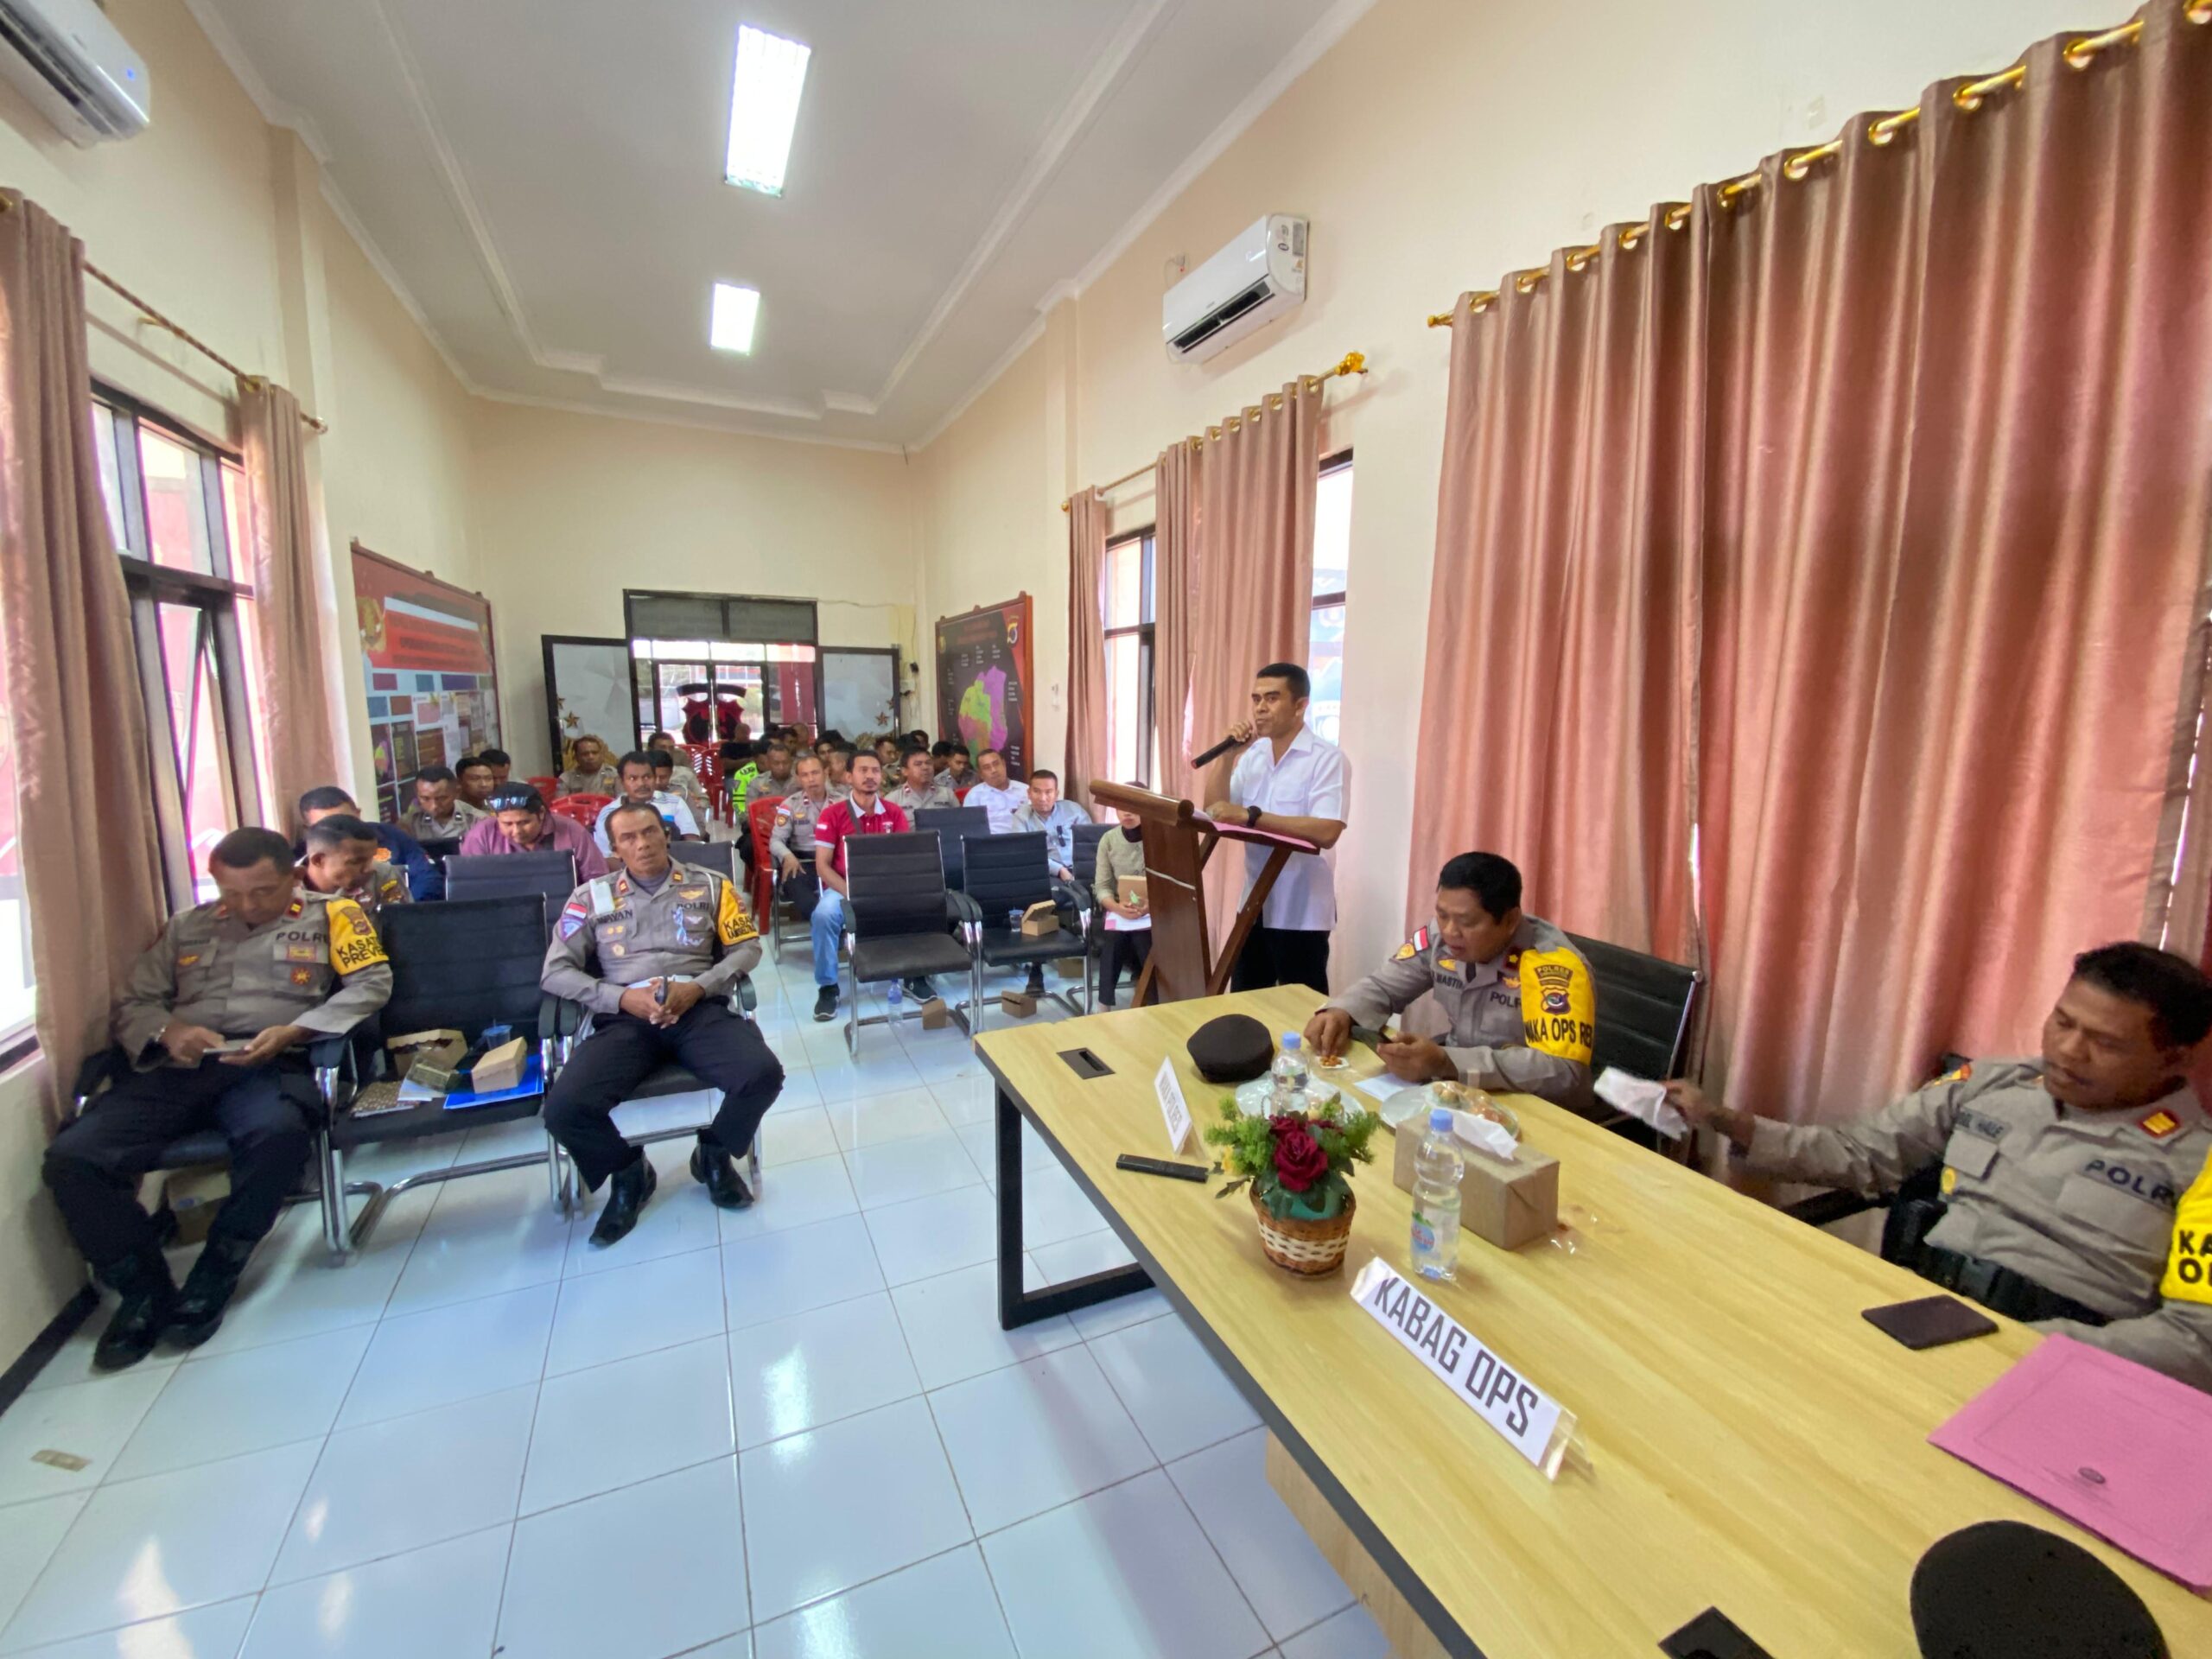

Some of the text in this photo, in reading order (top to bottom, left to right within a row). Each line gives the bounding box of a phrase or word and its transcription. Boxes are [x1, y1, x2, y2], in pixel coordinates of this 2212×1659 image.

[1551, 1018, 1577, 1044] OPS
[2177, 1258, 2212, 1287] O
[1374, 1277, 1538, 1438] KABAG OPS
